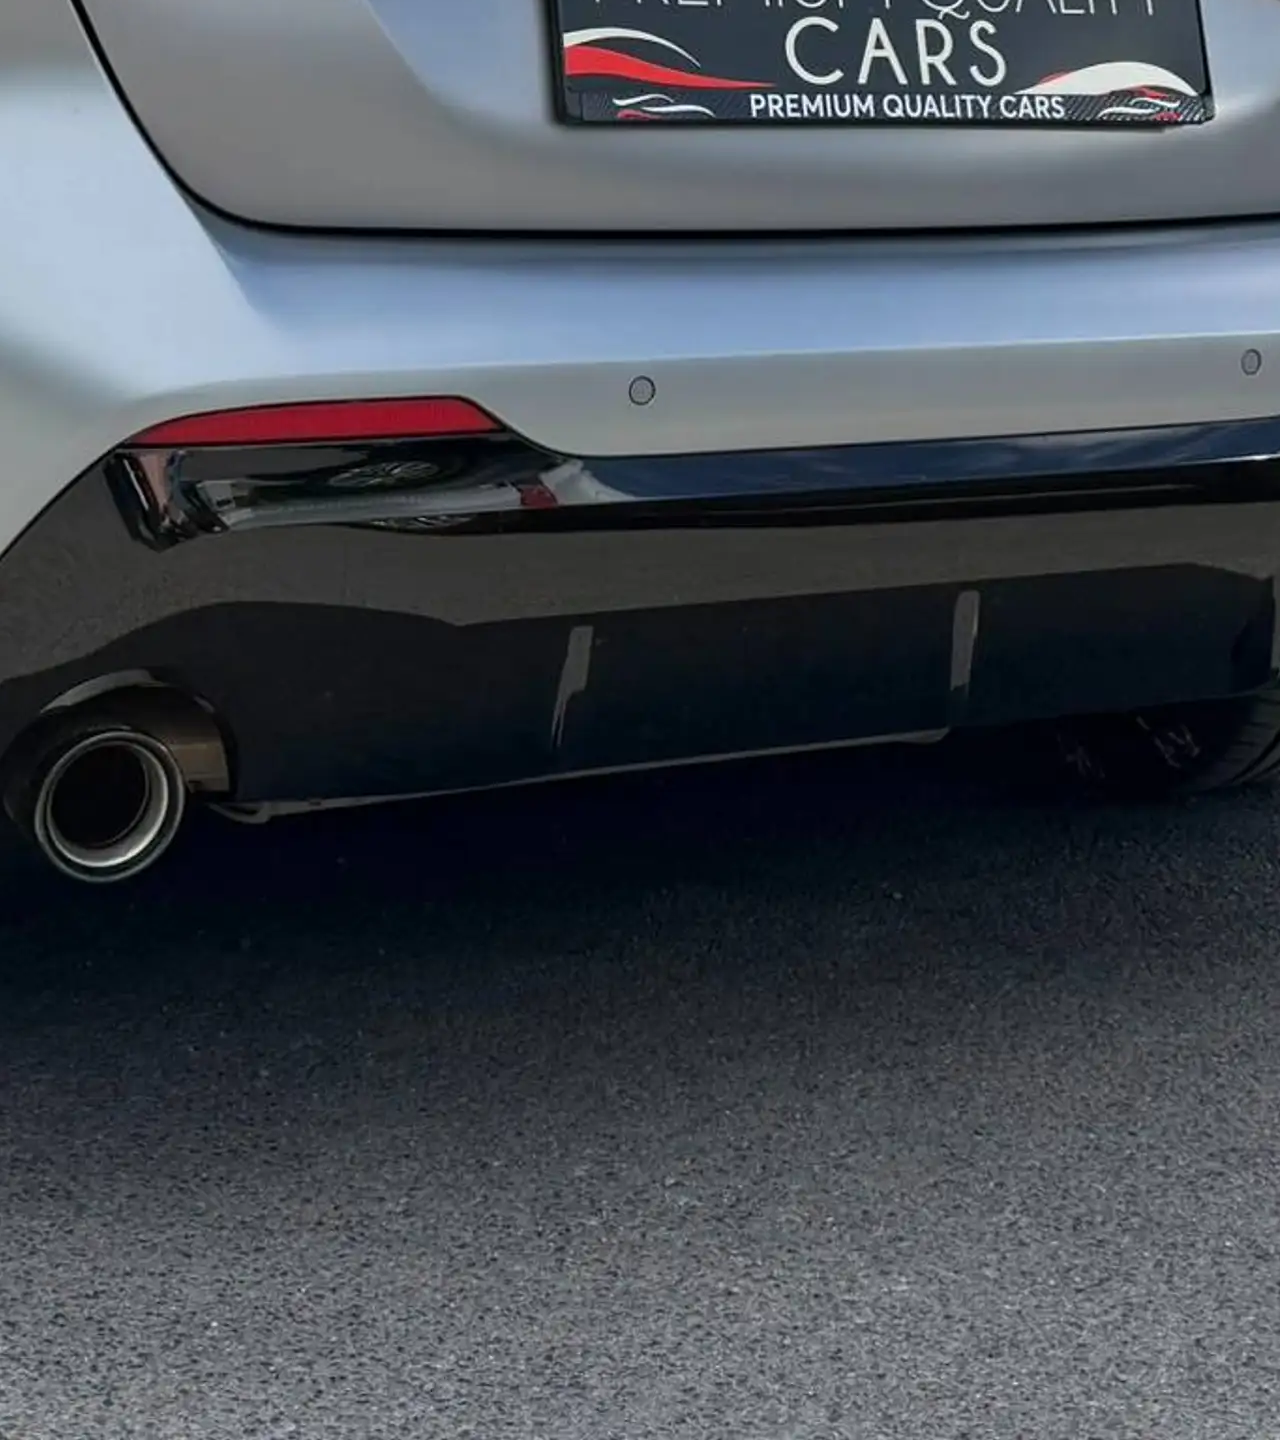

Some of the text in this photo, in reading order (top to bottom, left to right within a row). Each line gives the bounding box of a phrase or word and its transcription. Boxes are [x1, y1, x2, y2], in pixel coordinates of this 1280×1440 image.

[784, 15, 1007, 87] CARS
[748, 92, 1066, 120] PREMIUM QUALITY CARS
